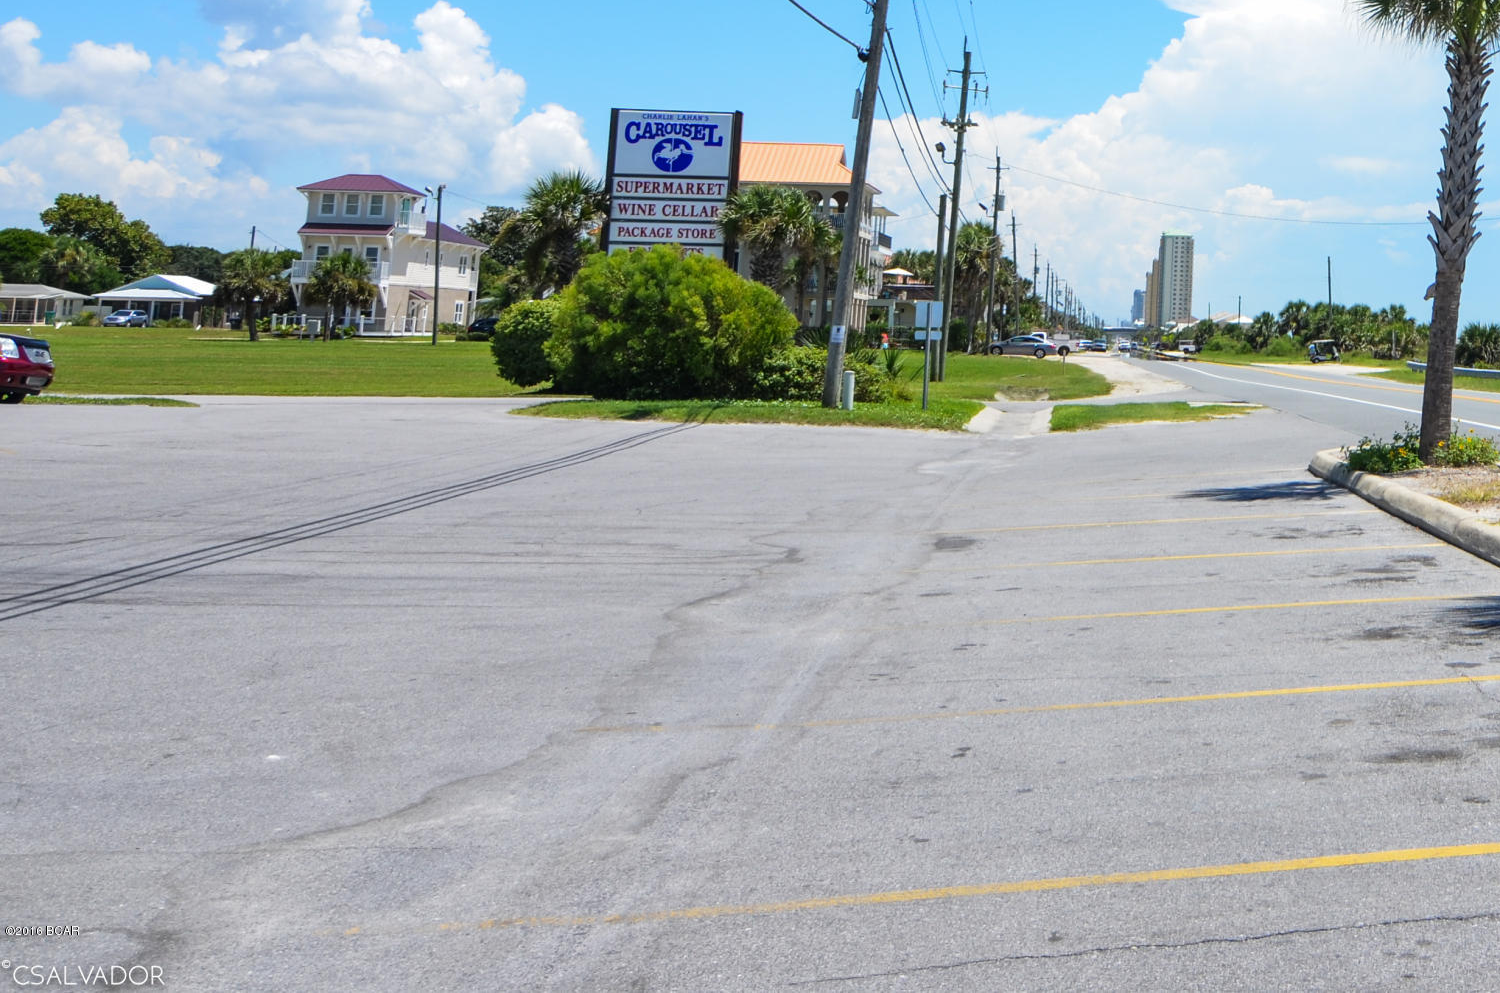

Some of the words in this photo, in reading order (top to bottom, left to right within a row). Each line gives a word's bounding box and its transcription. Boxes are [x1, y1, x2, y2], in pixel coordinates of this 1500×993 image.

[625, 121, 723, 147] CAROUSEL
[616, 180, 725, 196] SUPERMARKET
[617, 203, 657, 216] WINE
[662, 204, 719, 218] CELLAR
[617, 226, 673, 238] PACKAGE
[677, 228, 716, 239] STORE
